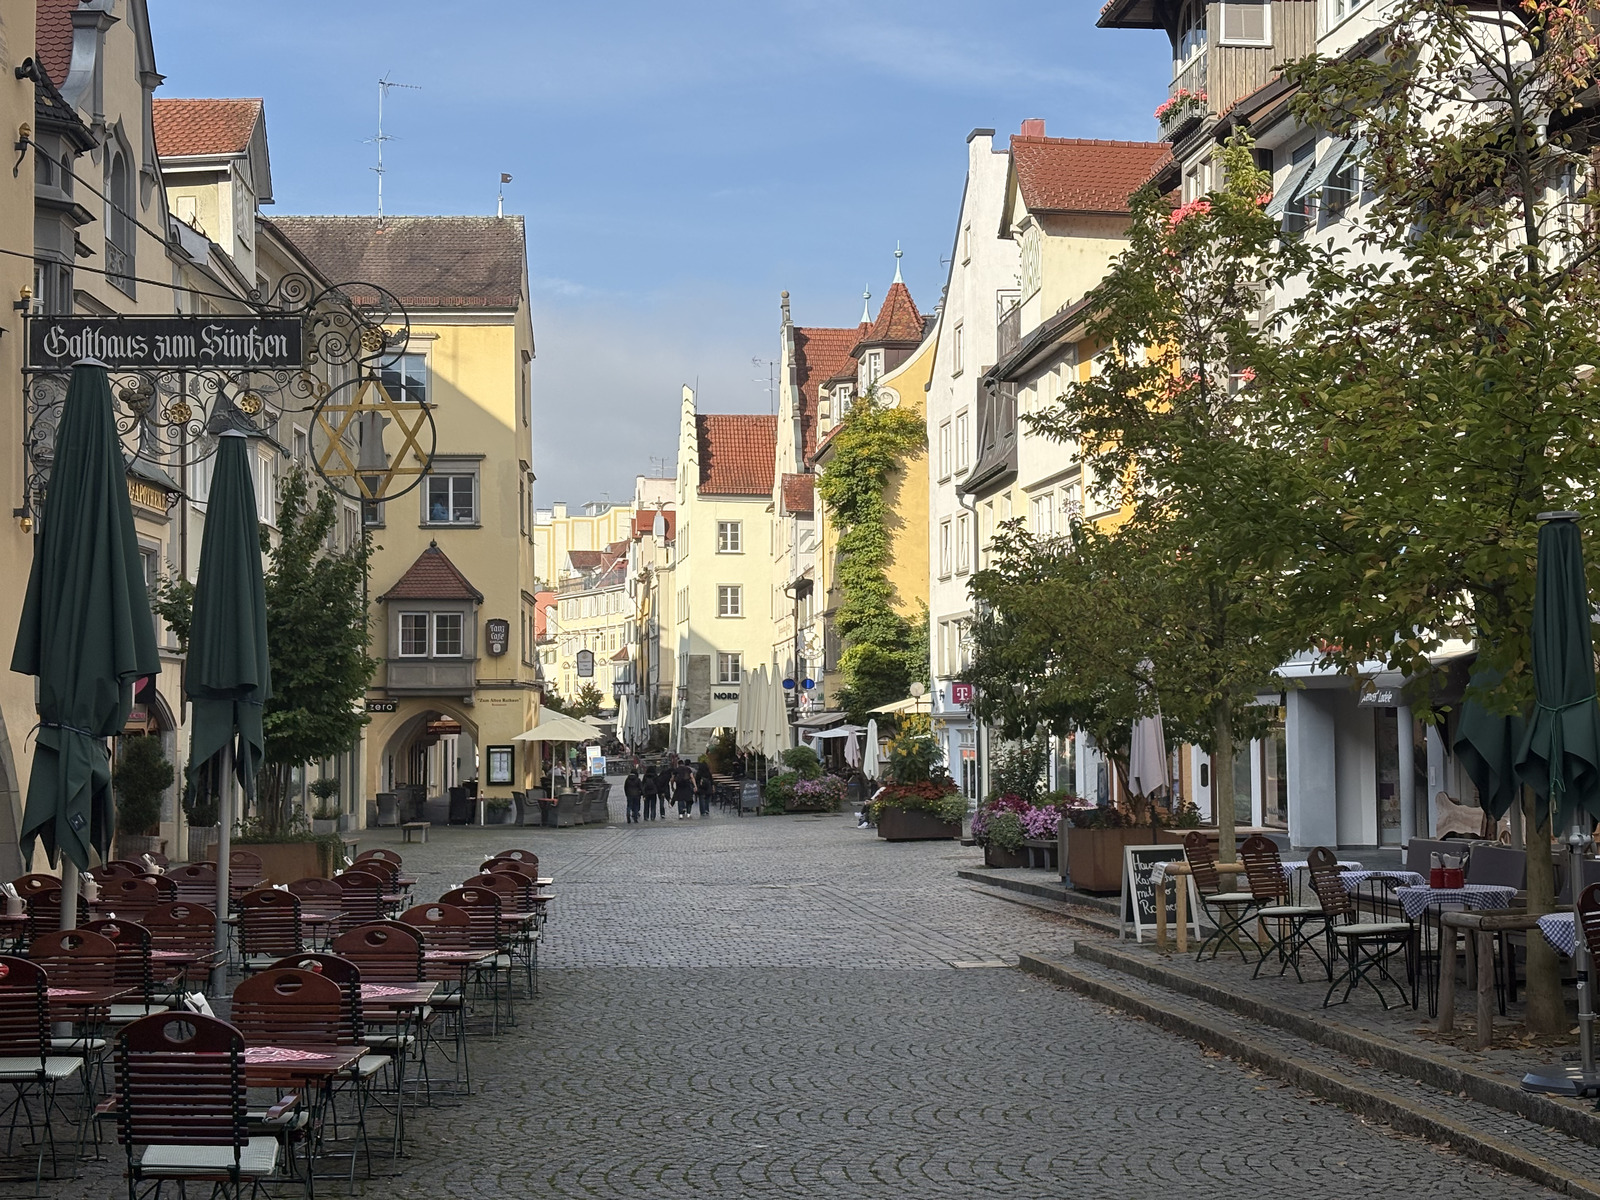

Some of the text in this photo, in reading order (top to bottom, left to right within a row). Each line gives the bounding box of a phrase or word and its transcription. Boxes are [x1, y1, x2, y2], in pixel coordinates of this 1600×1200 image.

[153, 333, 196, 362] zum
[490, 624, 505, 633] Tanz
[713, 692, 740, 700] NORD
[956, 687, 968, 701] T
